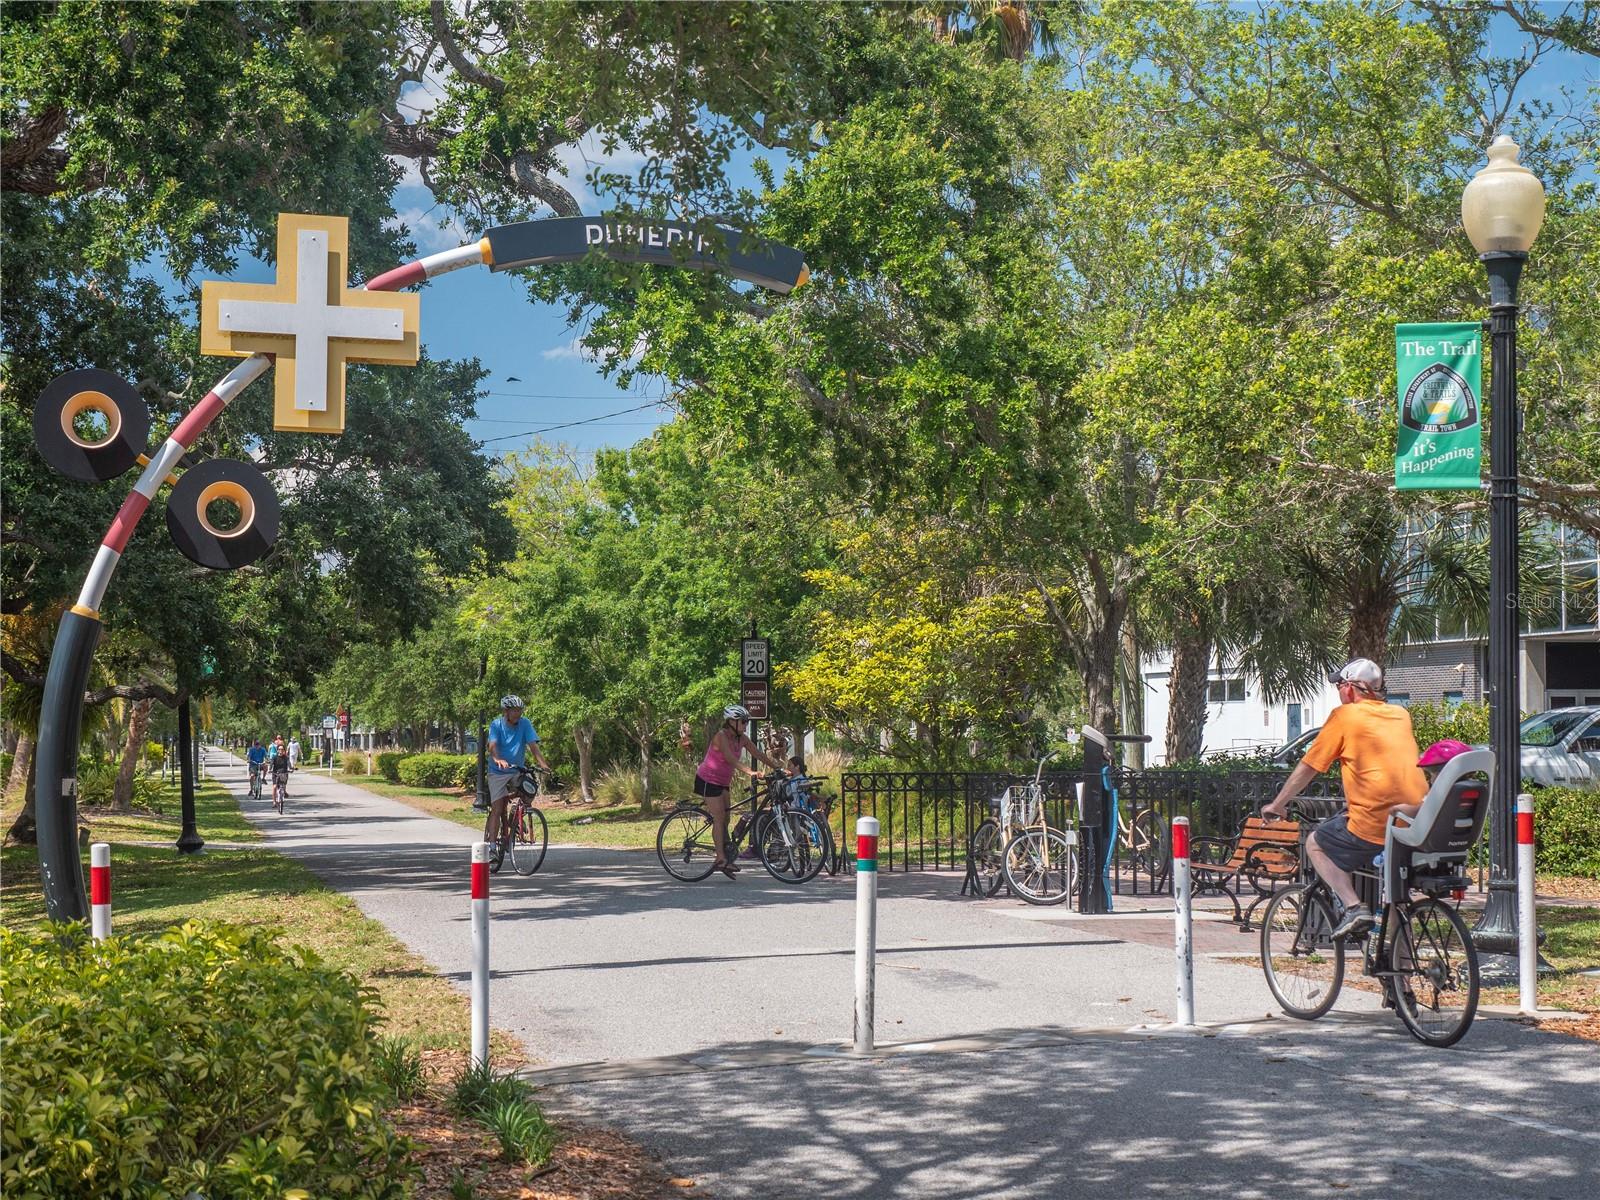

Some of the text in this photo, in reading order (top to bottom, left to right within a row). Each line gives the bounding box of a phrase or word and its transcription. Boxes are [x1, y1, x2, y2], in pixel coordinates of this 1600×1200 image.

[1402, 339, 1477, 357] The Trail
[1430, 389, 1456, 398] TRAILS
[1401, 446, 1475, 474] Happening
[747, 659, 765, 673] 20
